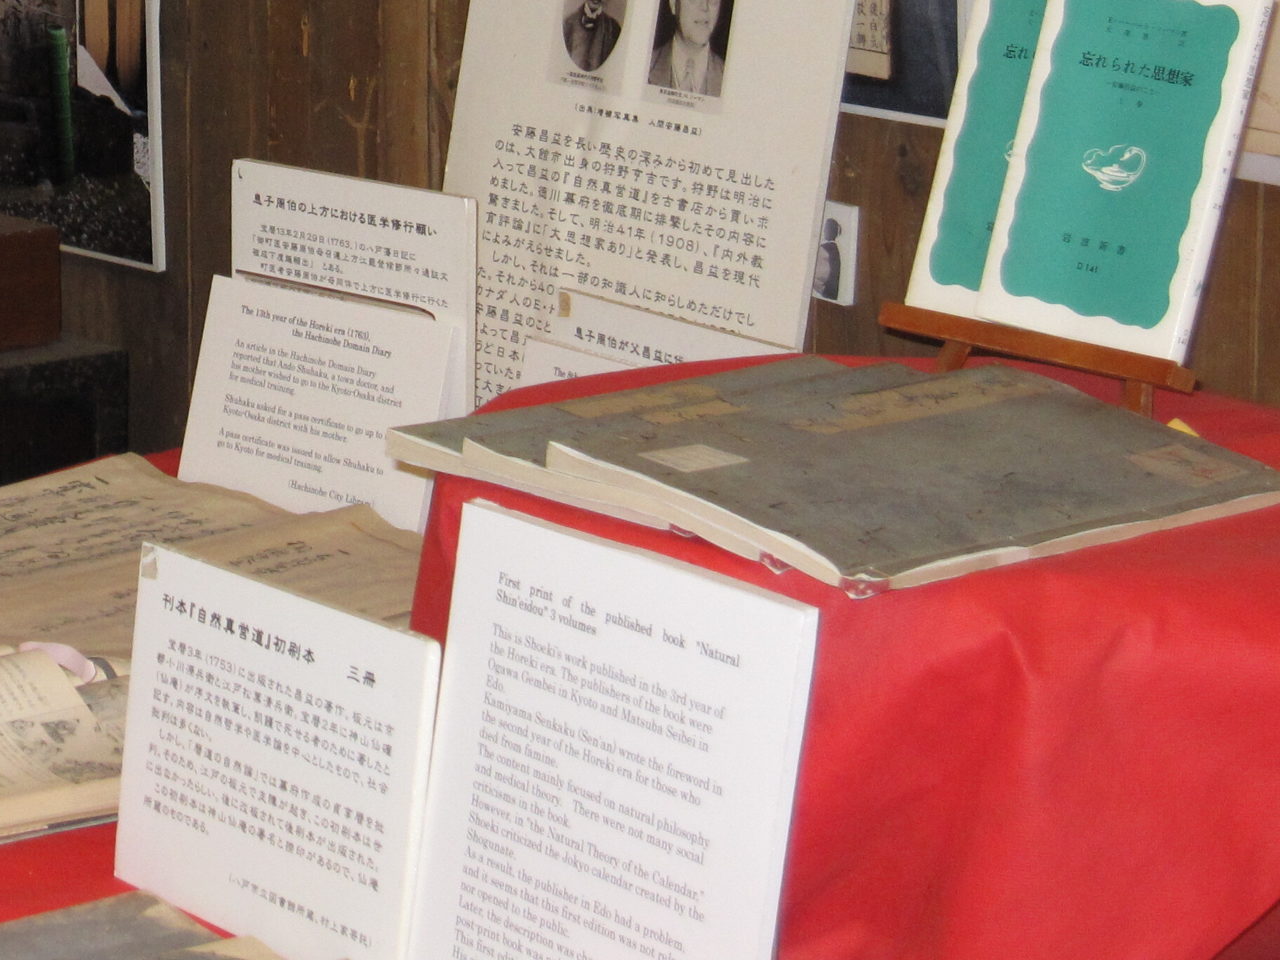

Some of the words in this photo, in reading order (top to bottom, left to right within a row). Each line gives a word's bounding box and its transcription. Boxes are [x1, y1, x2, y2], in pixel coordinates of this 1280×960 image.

[1079, 50, 1196, 88] 忘れられた思想家
[497, 571, 522, 591] First
[528, 585, 554, 602] print
[561, 595, 572, 609] of
[579, 599, 596, 617] the
[603, 612, 653, 637] published
[661, 628, 687, 649] book
[489, 640, 506, 657] the
[506, 646, 539, 670] Horeki
[560, 666, 579, 685] The
[579, 677, 631, 704] publishers
[631, 695, 644, 709] of
[643, 697, 661, 715] the
[661, 704, 687, 725] book
[687, 717, 713, 734] were
[491, 623, 513, 642] This
[513, 631, 523, 646] is
[563, 653, 588, 670] work
[588, 662, 638, 688] published
[637, 676, 650, 693] in
[650, 681, 668, 699] the
[687, 699, 712, 715] year
[712, 706, 725, 720] of
[480, 709, 497, 726] the
[497, 718, 530, 739] second
[529, 731, 552, 748] year
[552, 739, 563, 752] of
[563, 741, 580, 759] the
[581, 748, 616, 772] Horeki
[615, 765, 633, 780] era
[634, 769, 649, 786] for
[650, 775, 679, 797] those
[678, 790, 701, 806] who
